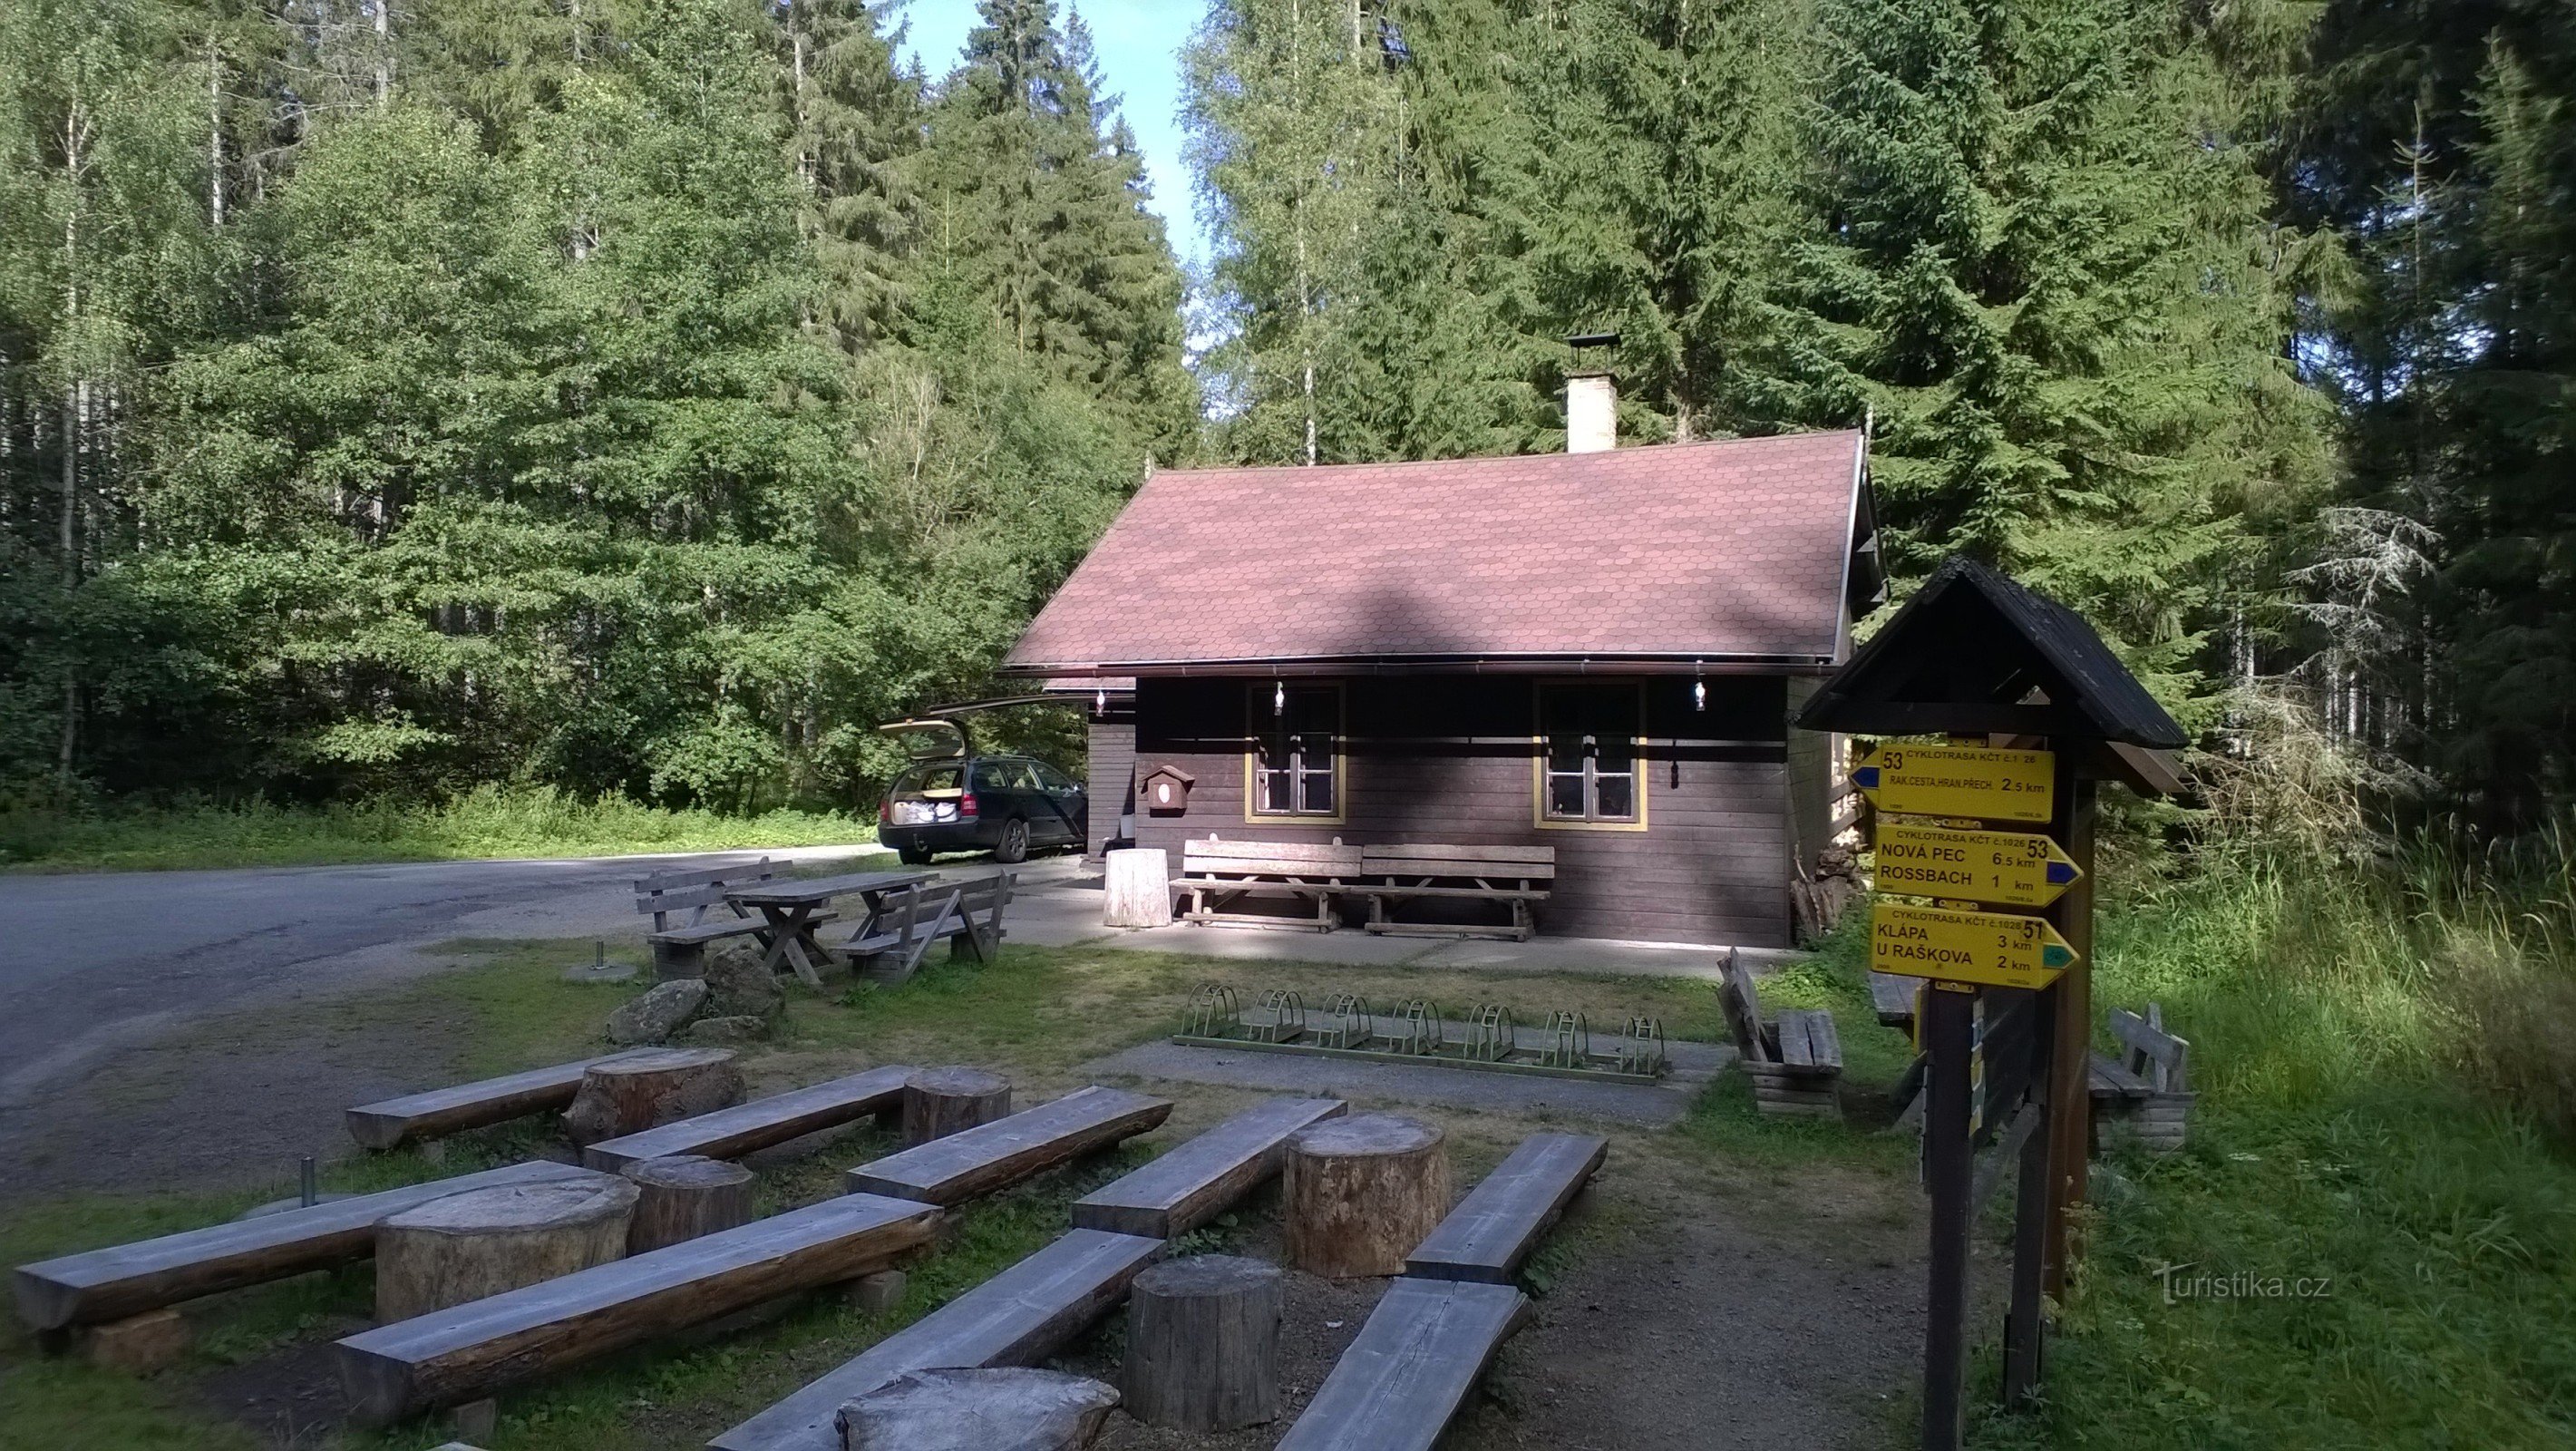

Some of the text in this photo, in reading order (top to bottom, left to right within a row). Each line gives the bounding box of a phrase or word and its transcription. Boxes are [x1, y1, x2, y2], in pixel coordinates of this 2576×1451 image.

[1883, 751, 1903, 770] 53
[1906, 749, 1977, 761] CYKLOTRASA
[1978, 752, 2000, 762] KČT
[2026, 783, 2046, 794] km
[1881, 842, 2036, 868] NOVÁ PEC 6.5 km
[1896, 830, 1967, 843] CYKLOTRASA
[1968, 835, 1990, 845] KČT
[2027, 839, 2049, 860] 53
[1880, 864, 2034, 891] ROSSBACH 1 km
[1877, 921, 2032, 951] KLÁPA 3 km
[1891, 910, 1963, 924] CYKLOTRASA
[1965, 916, 1987, 927] KČT
[2023, 920, 2044, 940] 51
[1876, 942, 2031, 971] U RAŠKOVA 2 km
